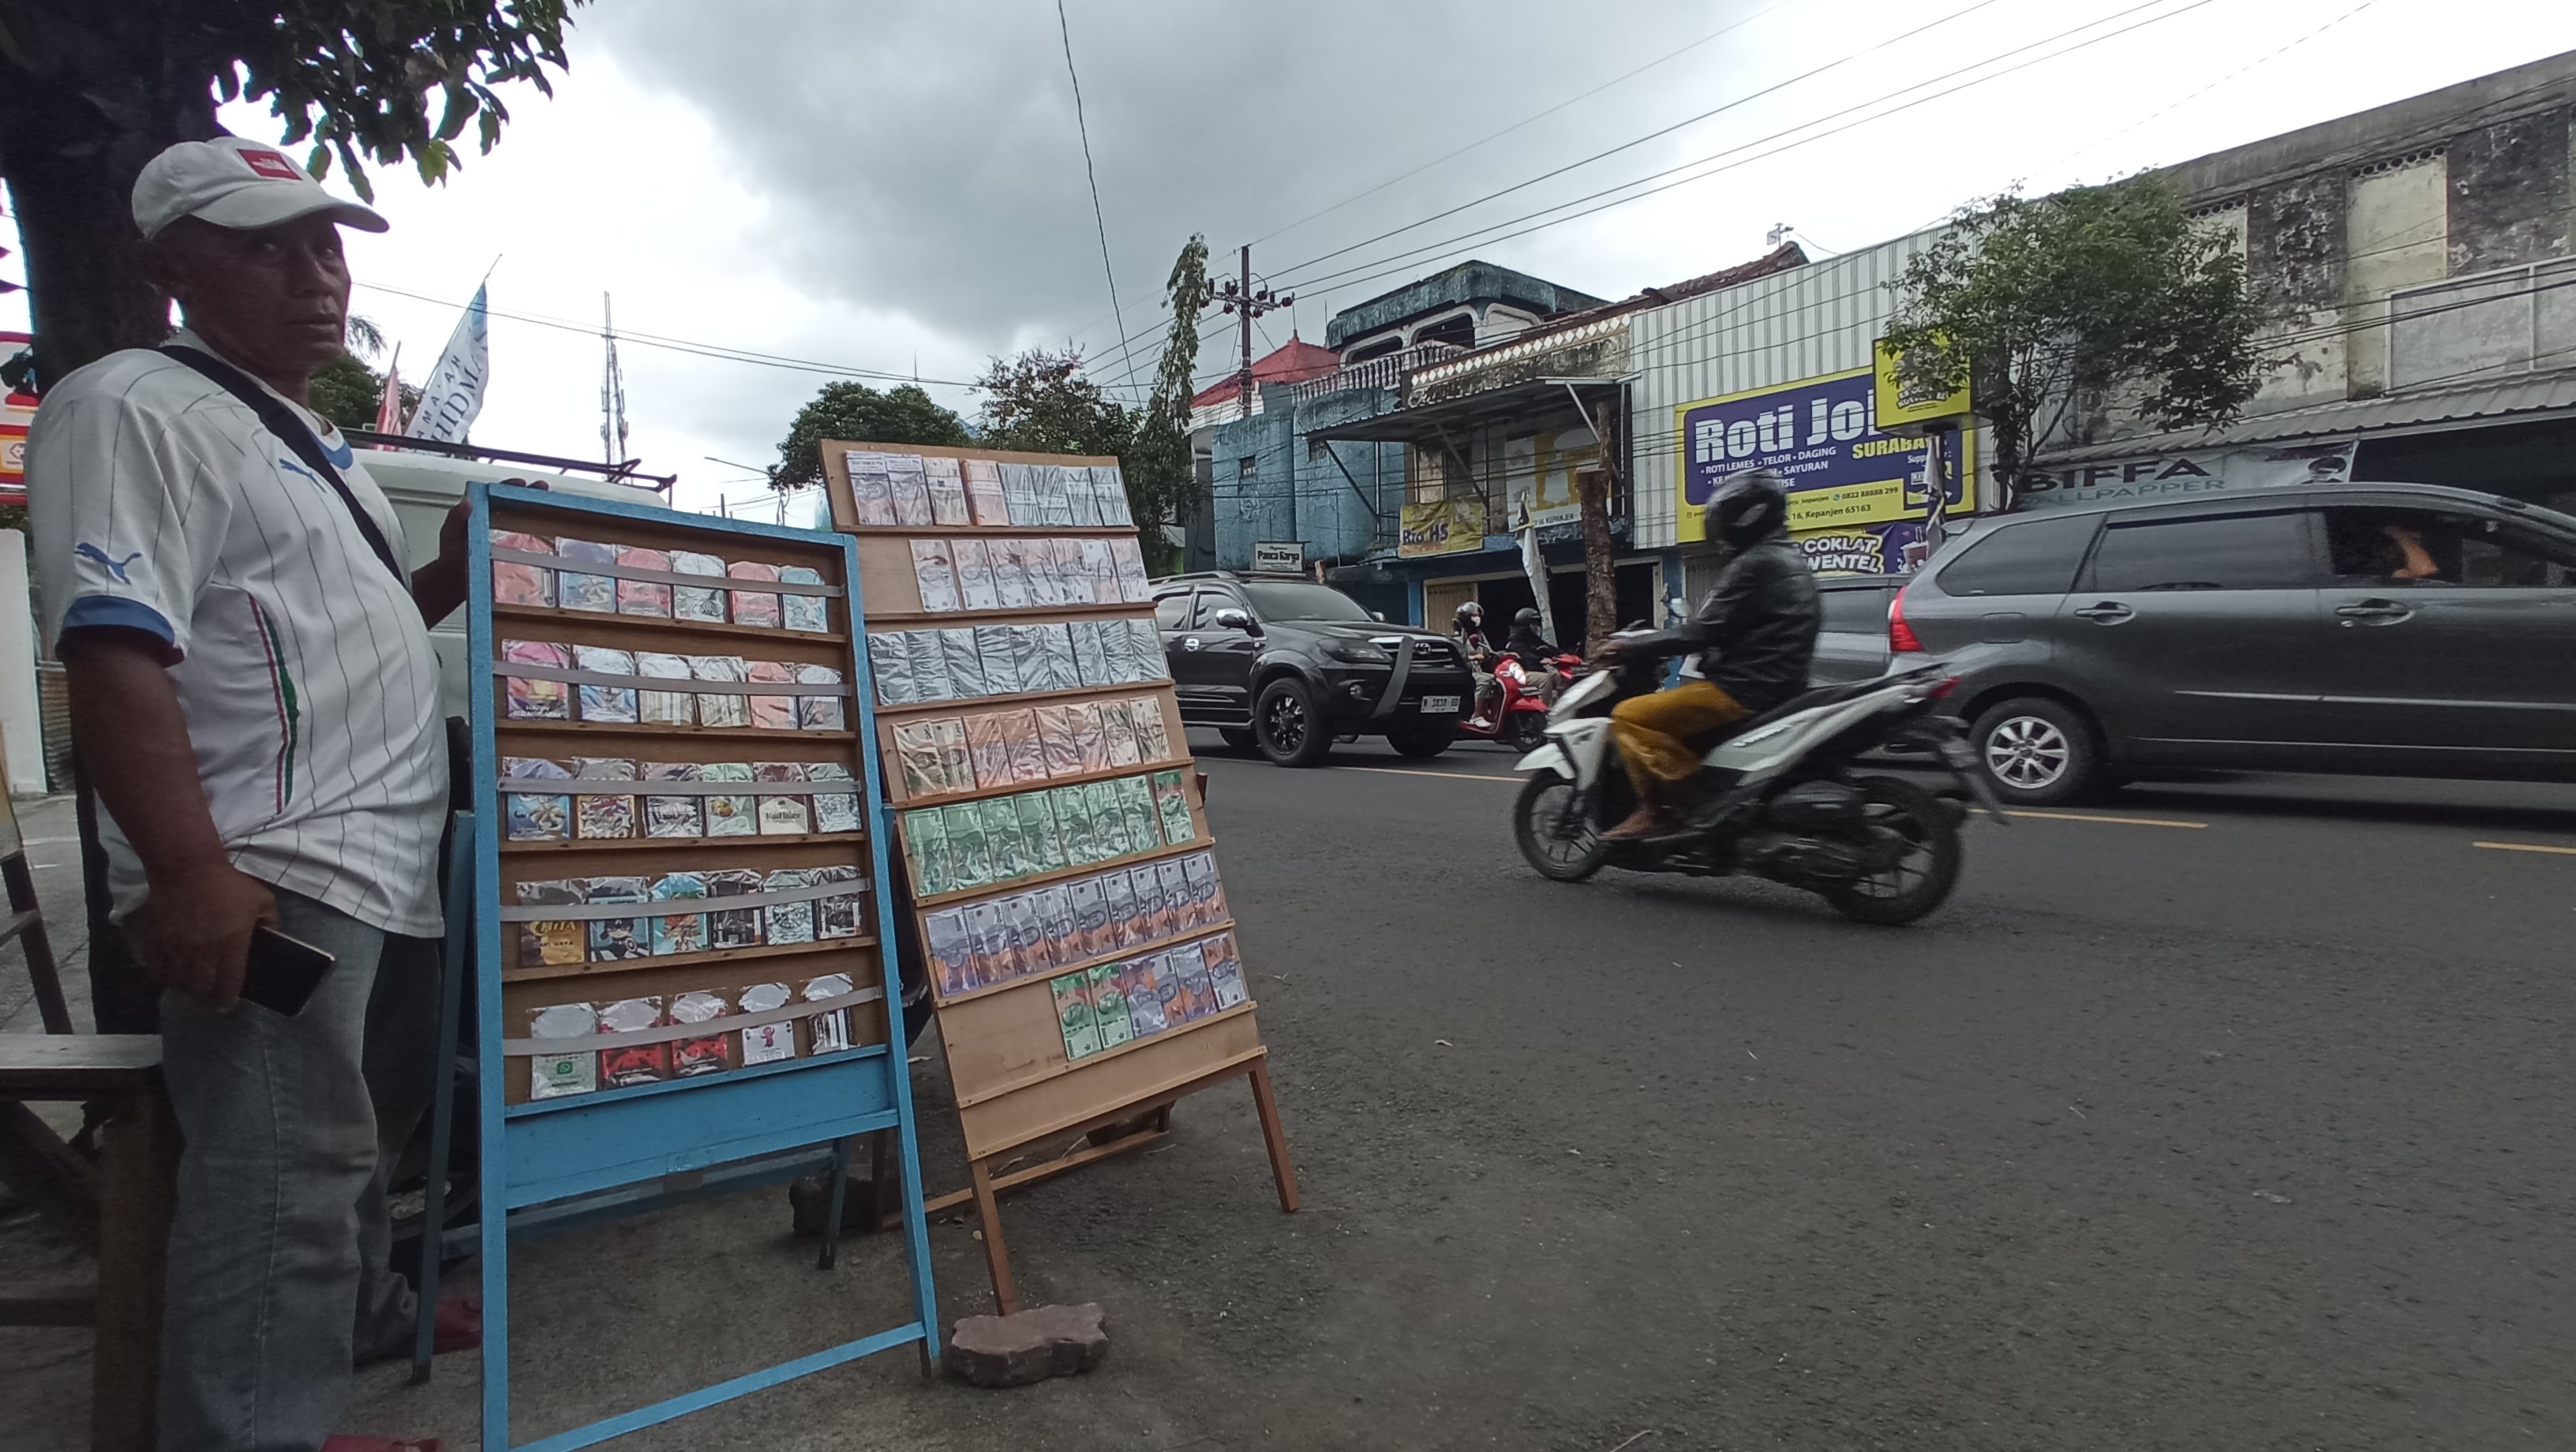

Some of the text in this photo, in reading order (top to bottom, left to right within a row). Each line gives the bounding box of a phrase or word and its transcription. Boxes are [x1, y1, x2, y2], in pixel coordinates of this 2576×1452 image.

[416, 354, 461, 440] AMA'AH
[1695, 390, 1882, 464] Roti Jo
[1705, 446, 1837, 474] ROTI LEMES TELOR DAGING
[1852, 437, 1929, 460] SURABA
[1784, 460, 1829, 475] SAYURAN
[1884, 486, 1899, 495] 299
[2031, 479, 2226, 507] ALLPAPPER
[1792, 512, 1804, 522] 16,
[1805, 507, 1844, 519] Kepanjen
[1844, 503, 1871, 514] 65163
[1803, 537, 1878, 553] COKLAT
